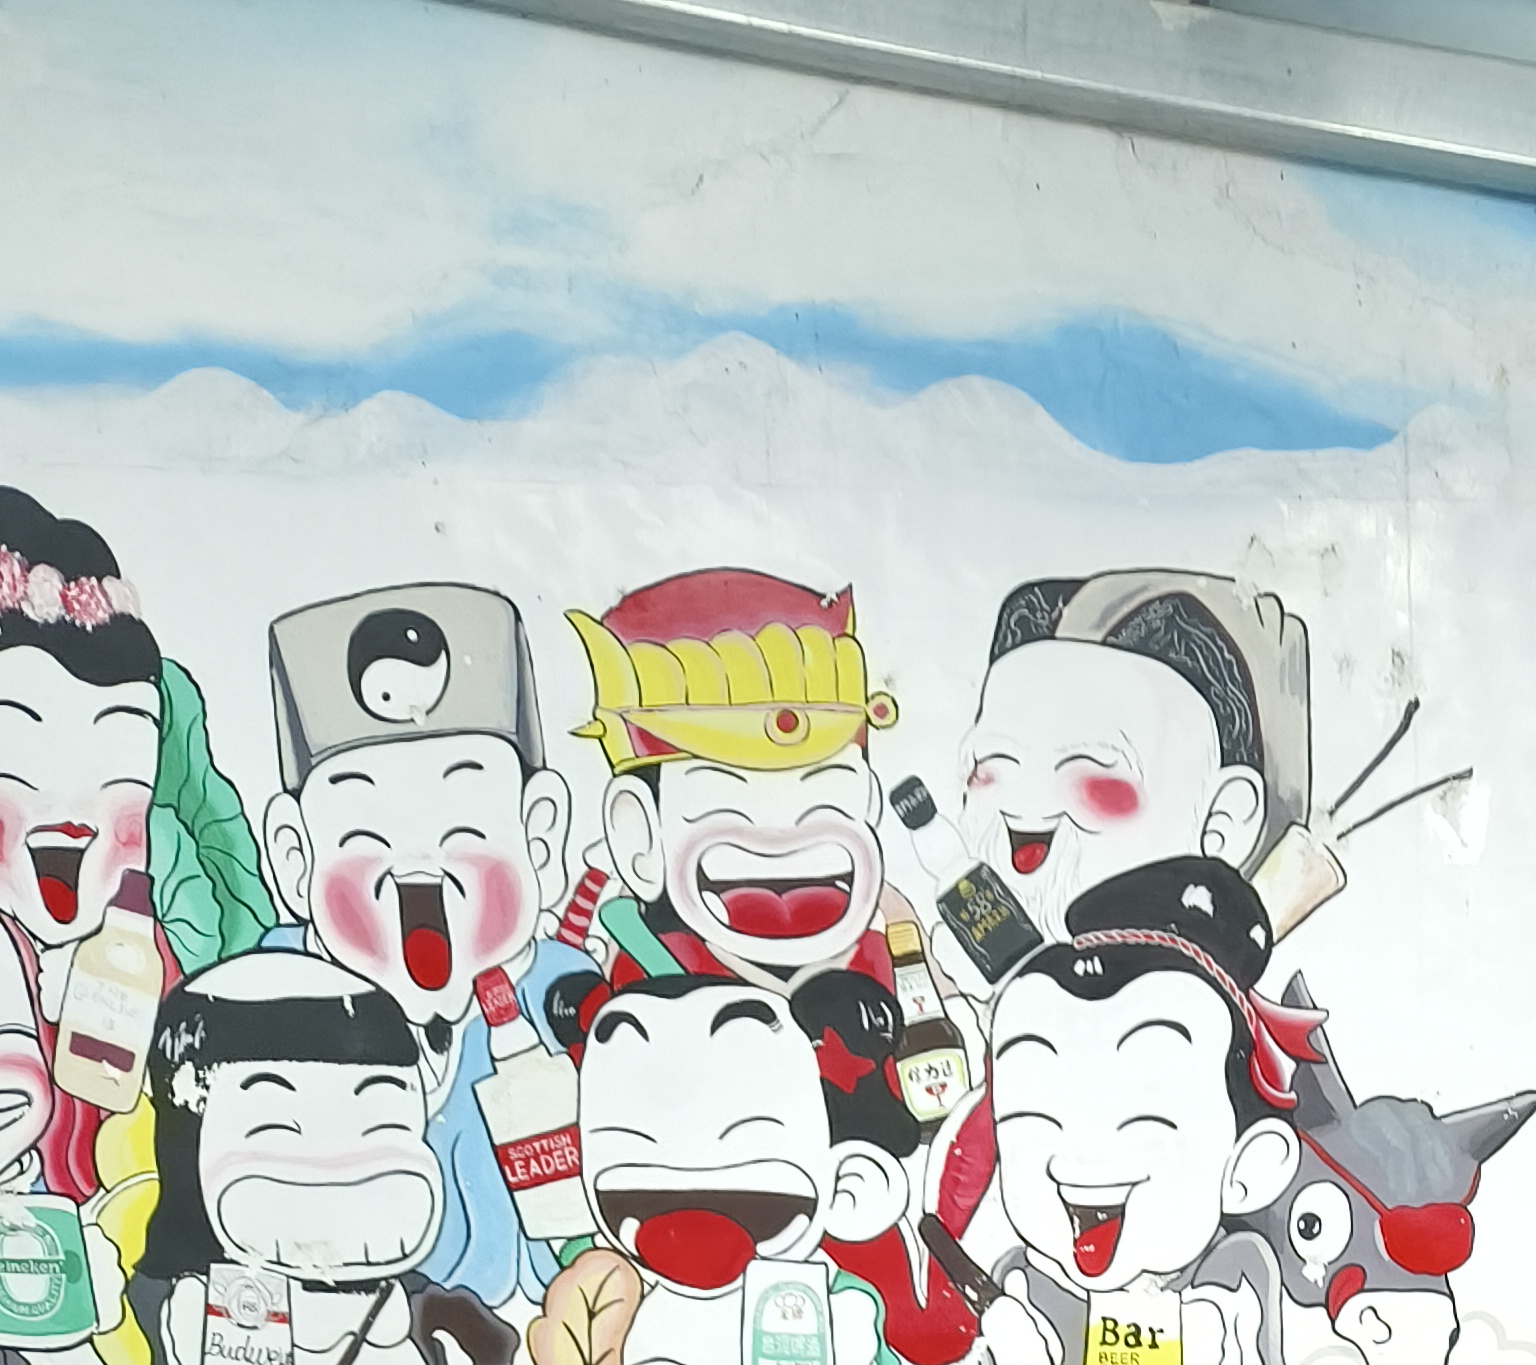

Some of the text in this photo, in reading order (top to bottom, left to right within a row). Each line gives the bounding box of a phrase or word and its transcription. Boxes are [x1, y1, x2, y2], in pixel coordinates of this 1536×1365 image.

[507, 1132, 572, 1161] SCOTTISH
[504, 1146, 580, 1184] LEADER
[1099, 1316, 1165, 1350] Bar
